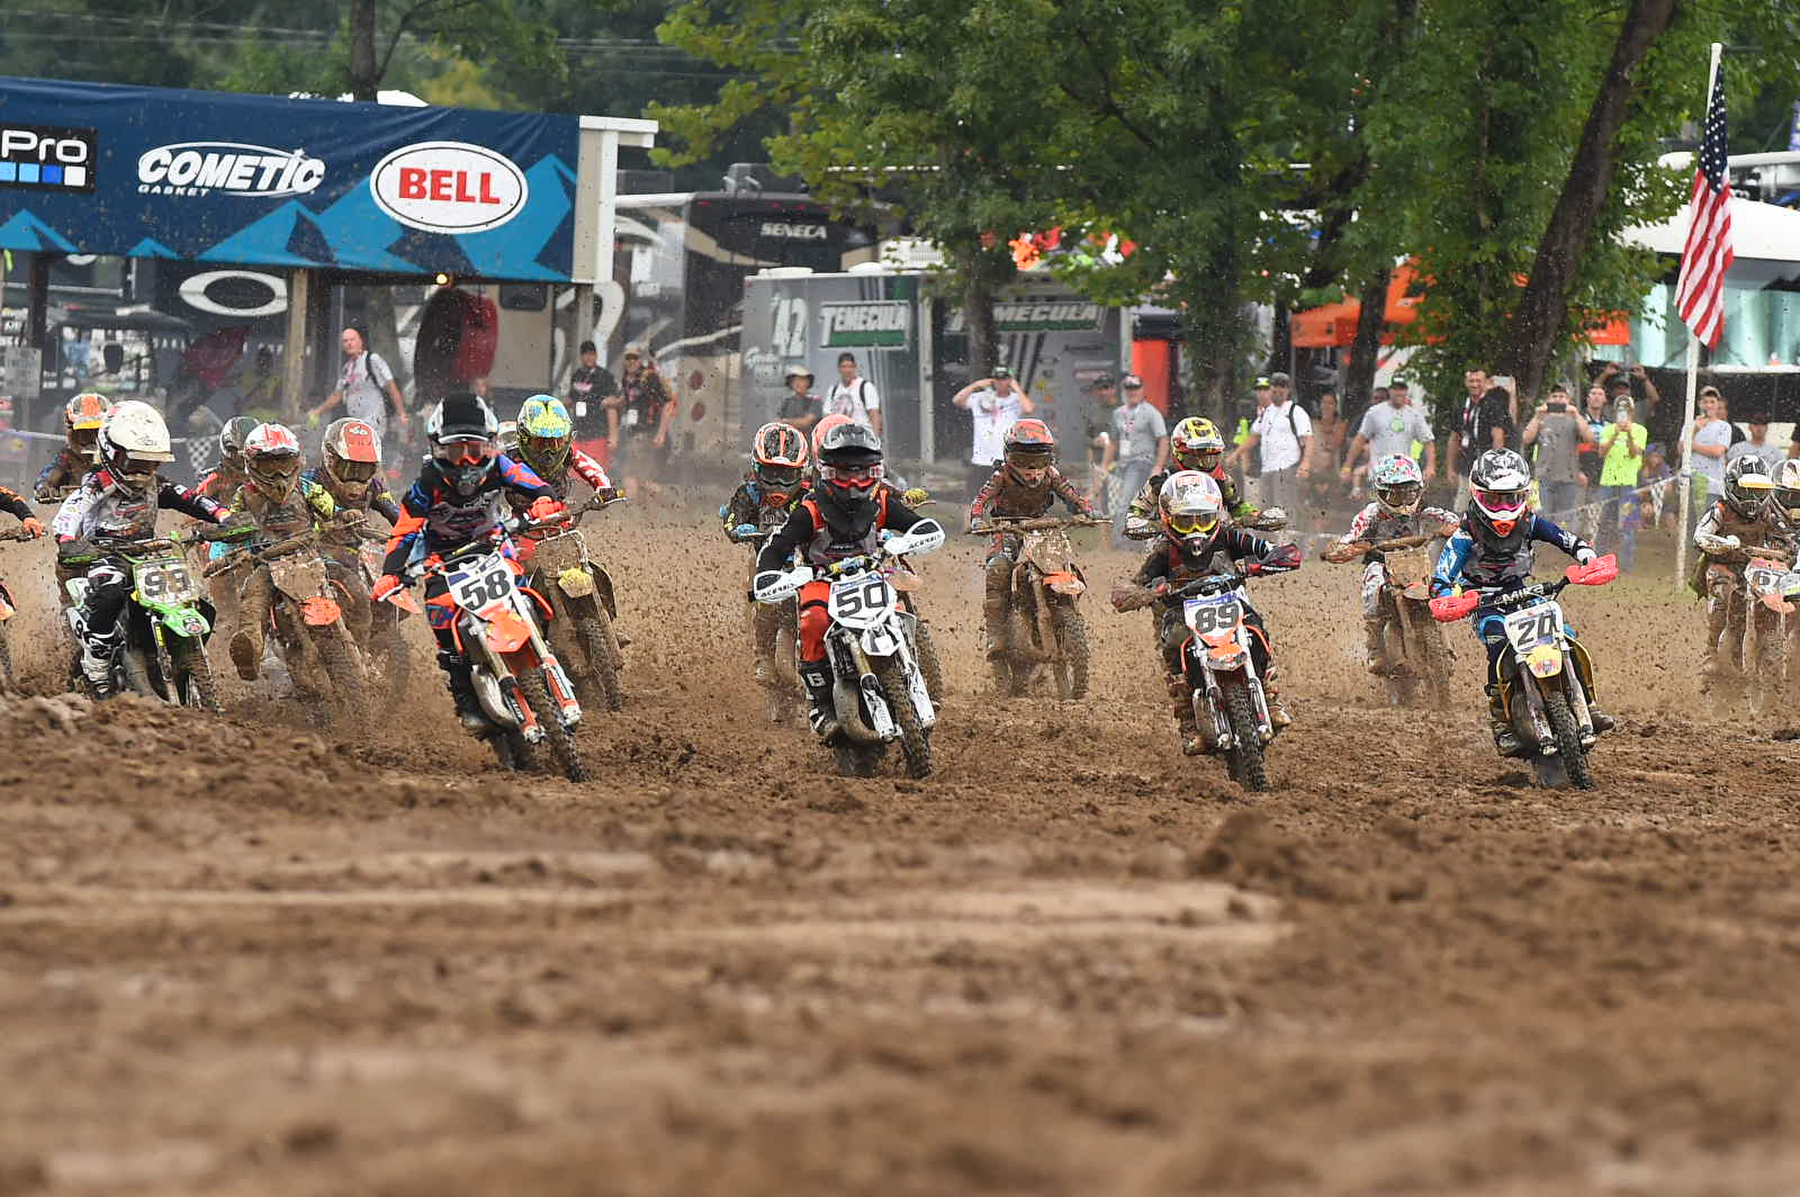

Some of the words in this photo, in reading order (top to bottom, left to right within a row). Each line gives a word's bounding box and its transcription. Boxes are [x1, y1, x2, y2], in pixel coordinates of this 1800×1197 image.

[138, 148, 326, 194] COMETIC
[398, 166, 501, 205] BELL
[761, 222, 827, 239] SENECA
[820, 305, 908, 347] TEMECULA
[944, 304, 1098, 332] TMECULA
[460, 569, 512, 611] 58
[836, 581, 889, 619] 50
[1195, 602, 1240, 634] 89
[1517, 609, 1558, 647] 20
